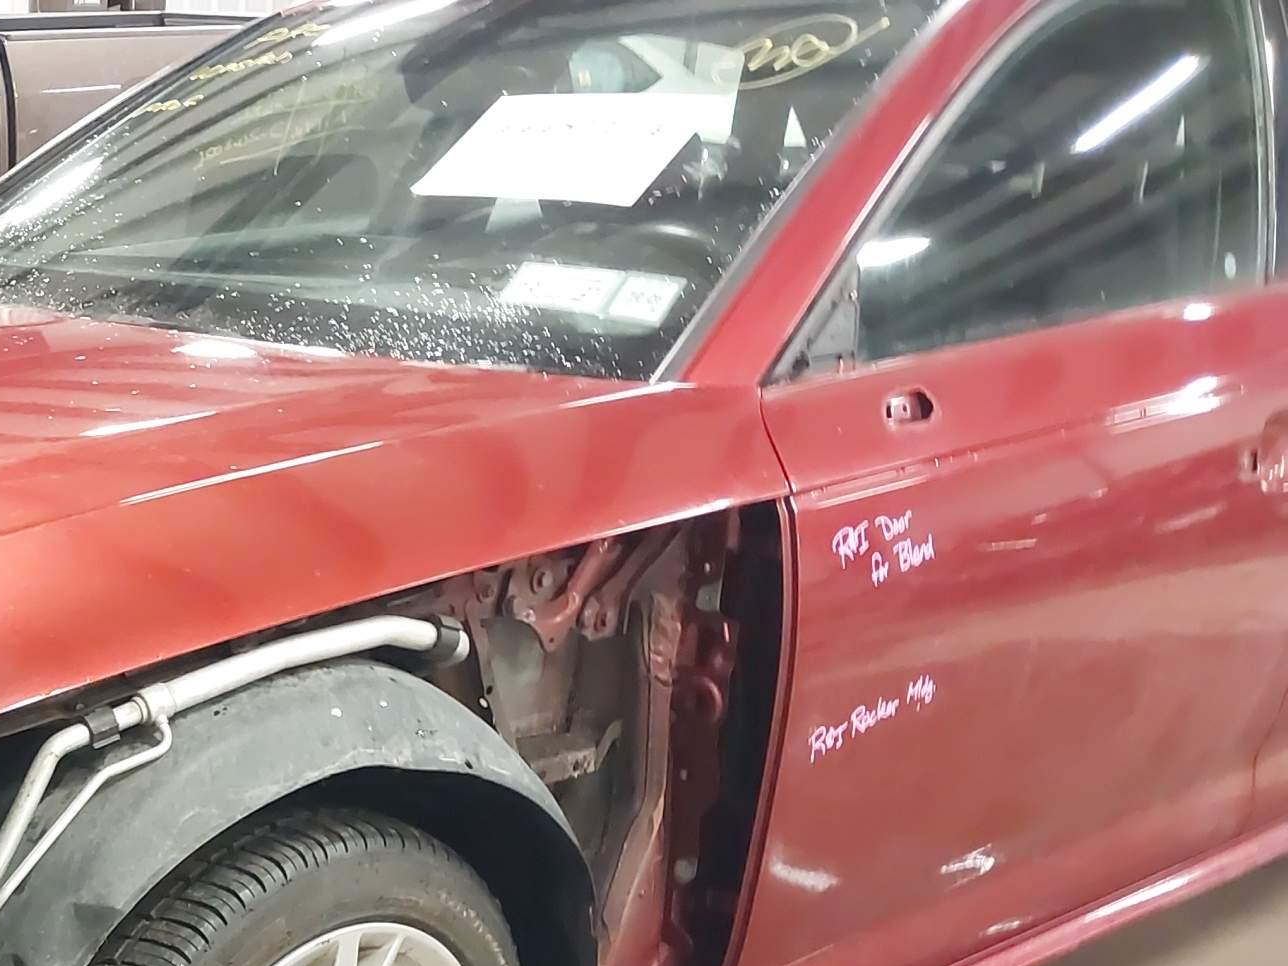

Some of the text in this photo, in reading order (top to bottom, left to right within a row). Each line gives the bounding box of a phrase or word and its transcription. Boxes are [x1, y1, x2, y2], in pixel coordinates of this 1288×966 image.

[874, 509, 912, 542] Door
[893, 532, 935, 573] Blend
[850, 697, 900, 739] Rocker
